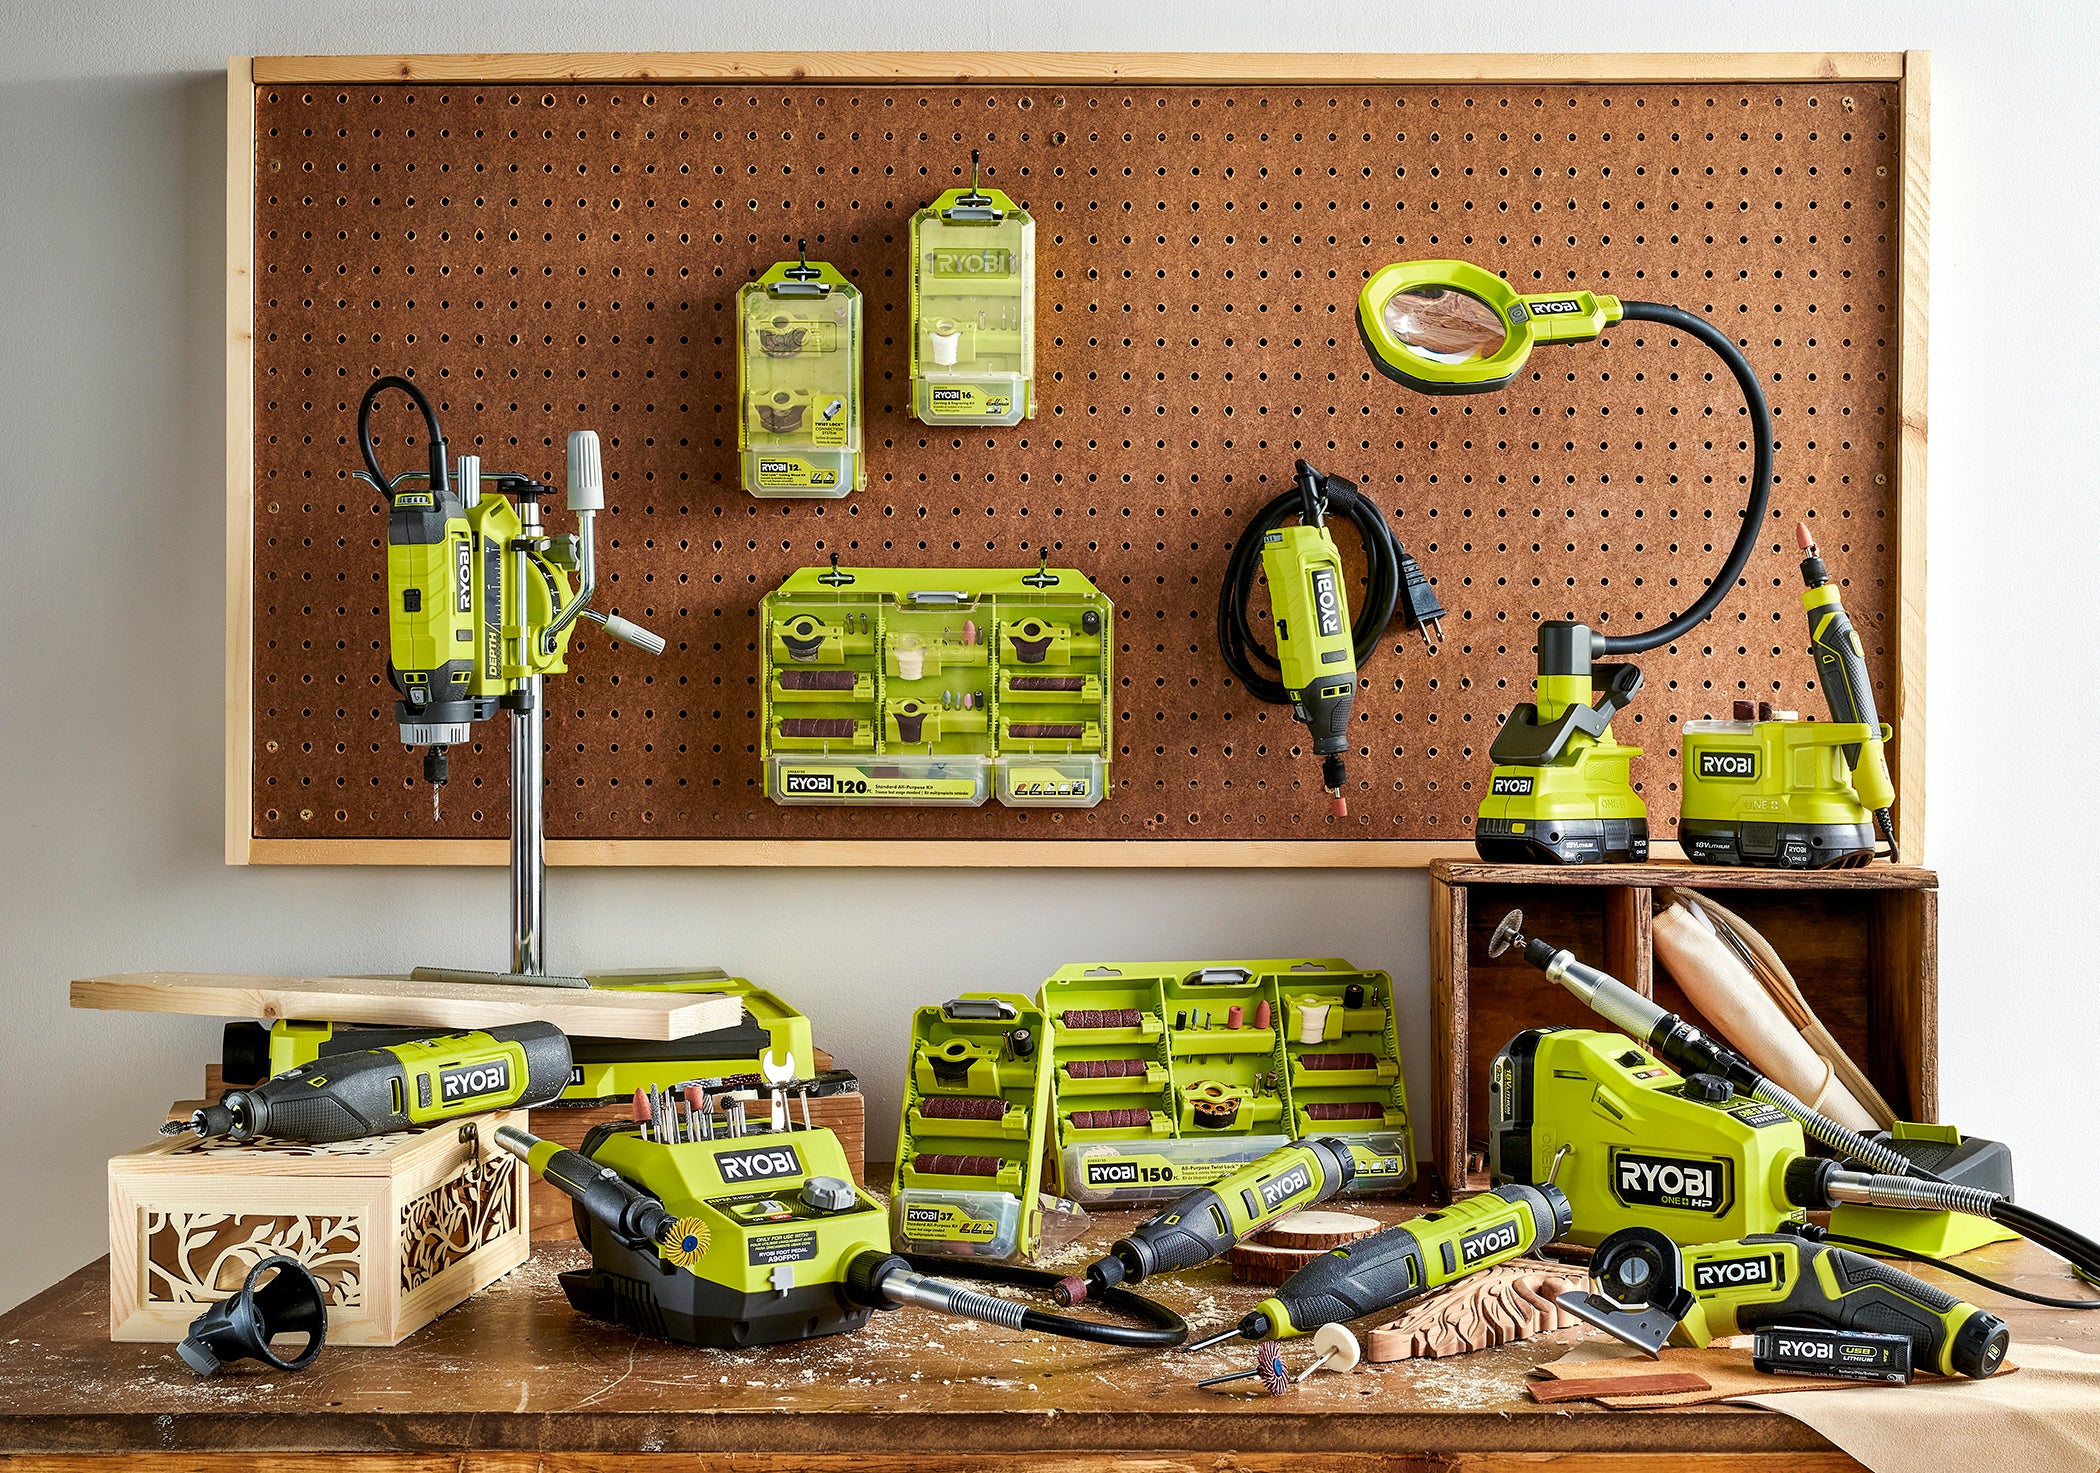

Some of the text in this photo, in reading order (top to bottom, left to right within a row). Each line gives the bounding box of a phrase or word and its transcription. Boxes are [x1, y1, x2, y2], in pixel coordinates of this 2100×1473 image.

[936, 254, 1006, 273] RYOBI
[1531, 301, 1579, 314] RYOBI
[934, 391, 972, 399] RYOBI 16
[761, 463, 799, 472] RYOBI 12
[459, 545, 470, 610] RYOBI
[1316, 573, 1339, 634] RYOBI
[488, 632, 498, 677] DEPTH
[1703, 756, 1752, 774] RYOBI
[789, 777, 831, 790] RYOBI
[836, 780, 867, 794] 120
[1494, 779, 1532, 793] RYOBI
[443, 1066, 505, 1097] RYOBI
[720, 1151, 797, 1179] RYOBI
[1090, 1165, 1136, 1181] RYOBI
[1140, 1166, 1174, 1183] 150
[1262, 1169, 1308, 1205] RYOBI
[1619, 1161, 1713, 1198] RYOBI
[708, 1196, 733, 1205] RPM
[1691, 1198, 1713, 1208] HP
[908, 1210, 954, 1221] RYOBI 37
[1463, 1225, 1516, 1260] RYOBI
[758, 1250, 776, 1258] RYOBI
[767, 1253, 800, 1263] A90FP01
[1697, 1260, 1767, 1285] RYOBI
[1778, 1340, 1872, 1360] RYOBI USB
[1842, 1355, 1874, 1363] LITHIUM
